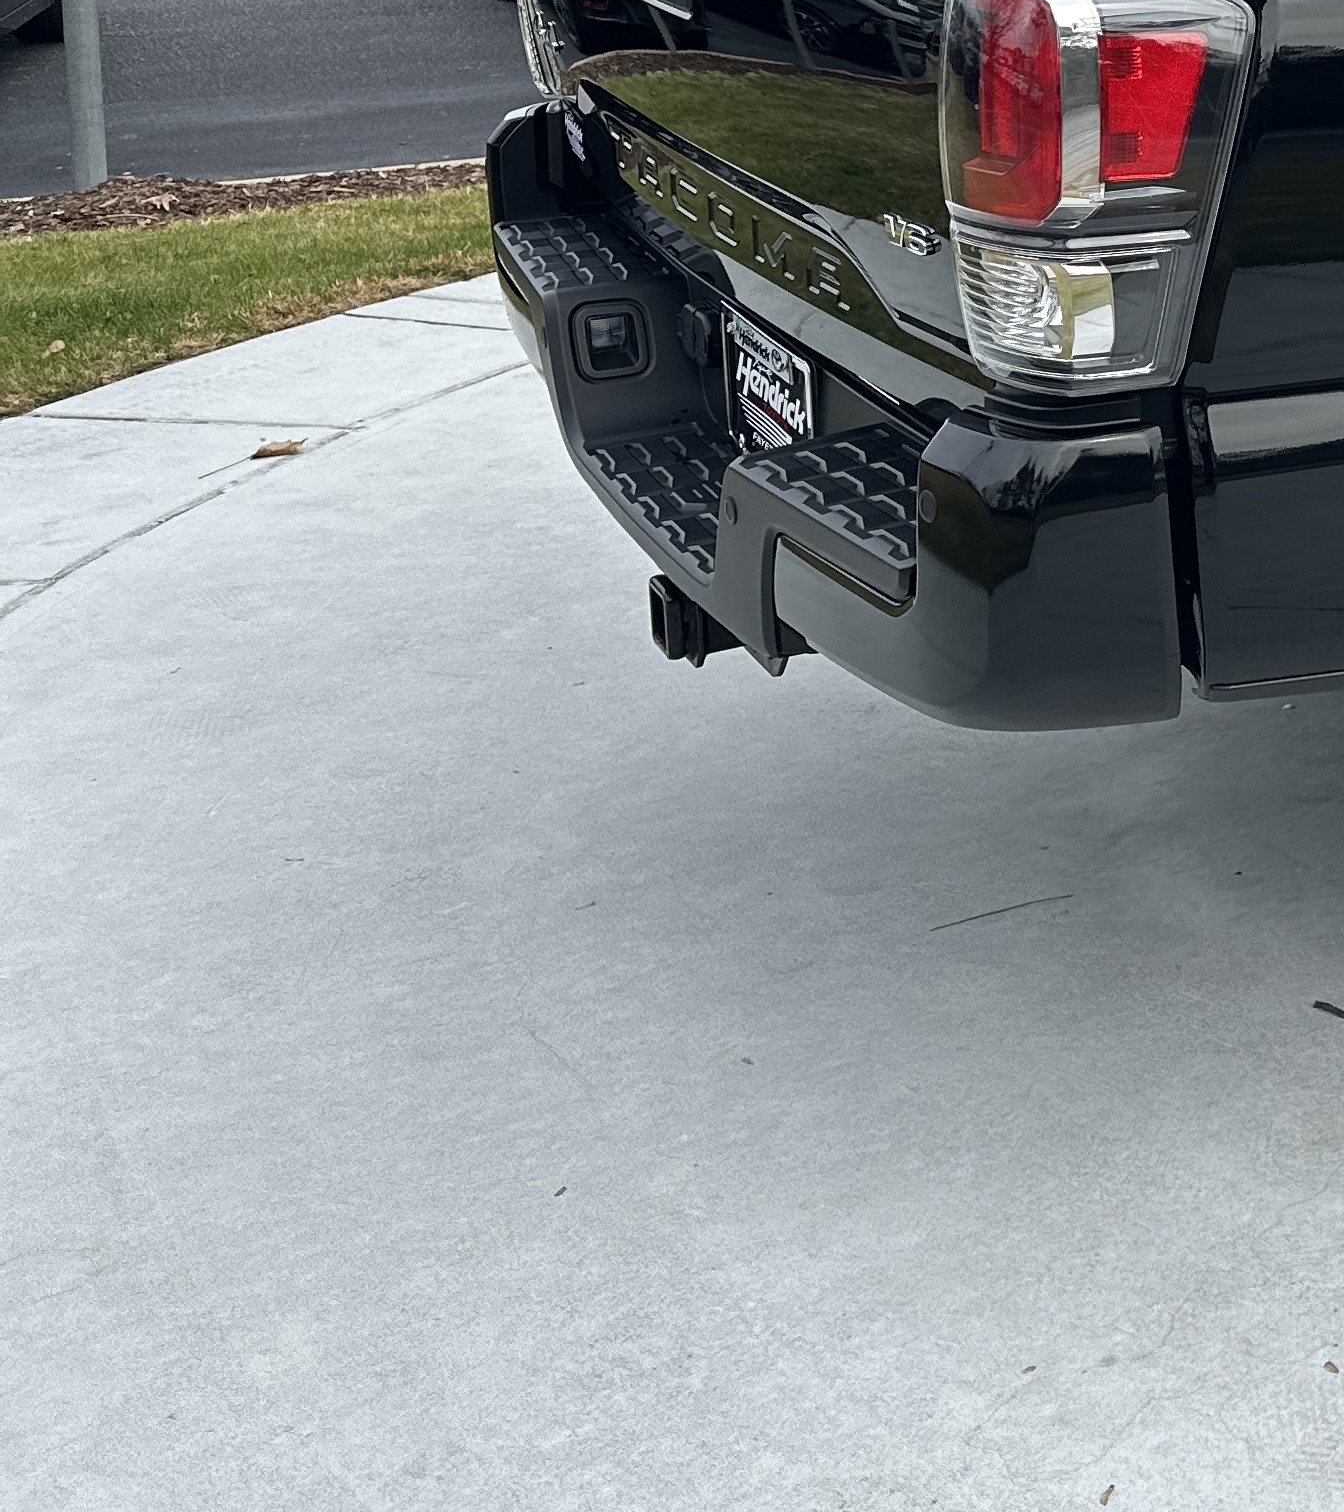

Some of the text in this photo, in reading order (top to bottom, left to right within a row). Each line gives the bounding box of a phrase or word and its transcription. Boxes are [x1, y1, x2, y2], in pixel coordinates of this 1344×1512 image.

[607, 125, 850, 312] TACOMA
[883, 213, 942, 256] V6
[735, 350, 806, 435] Hendrick
